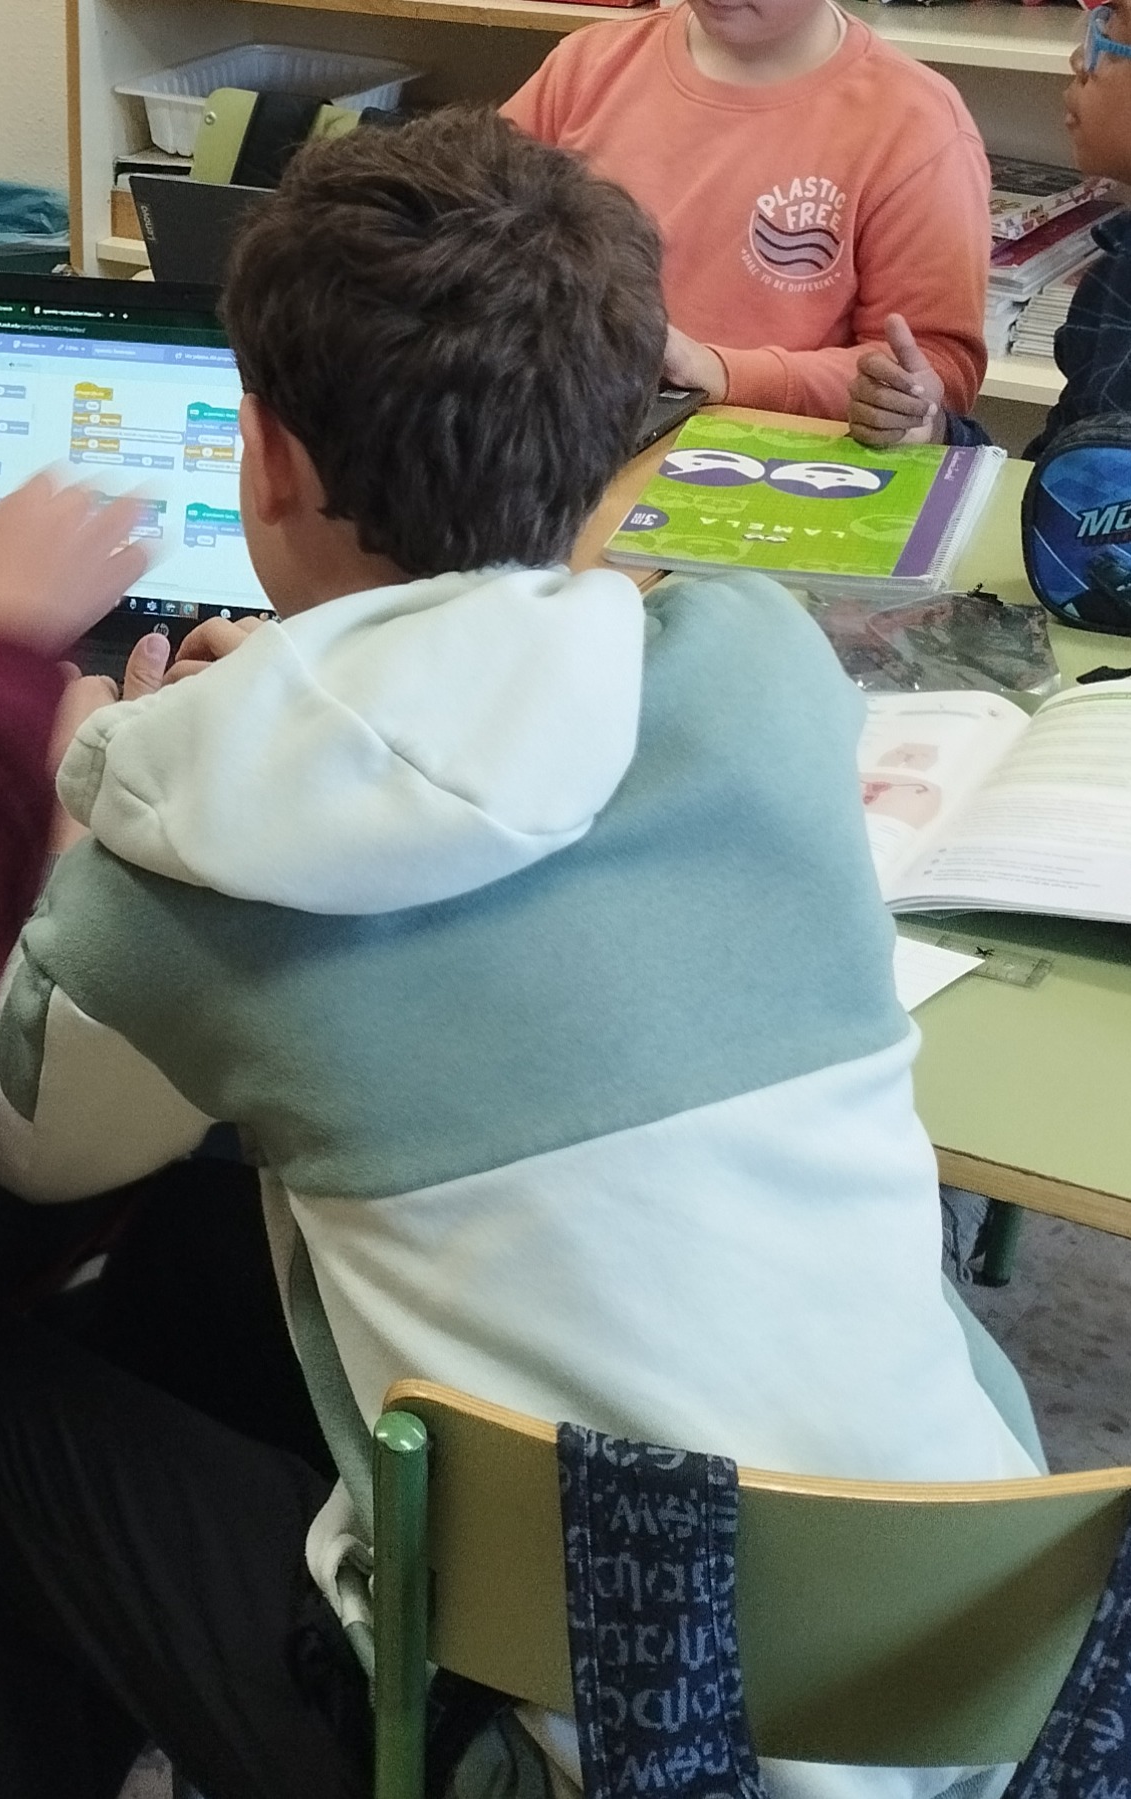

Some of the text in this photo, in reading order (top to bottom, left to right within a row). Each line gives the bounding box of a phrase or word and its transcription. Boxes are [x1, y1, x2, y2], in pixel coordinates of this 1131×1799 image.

[756, 175, 847, 219] PLASTIC
[785, 201, 842, 232] FREE
[700, 516, 846, 539] LAMELA
